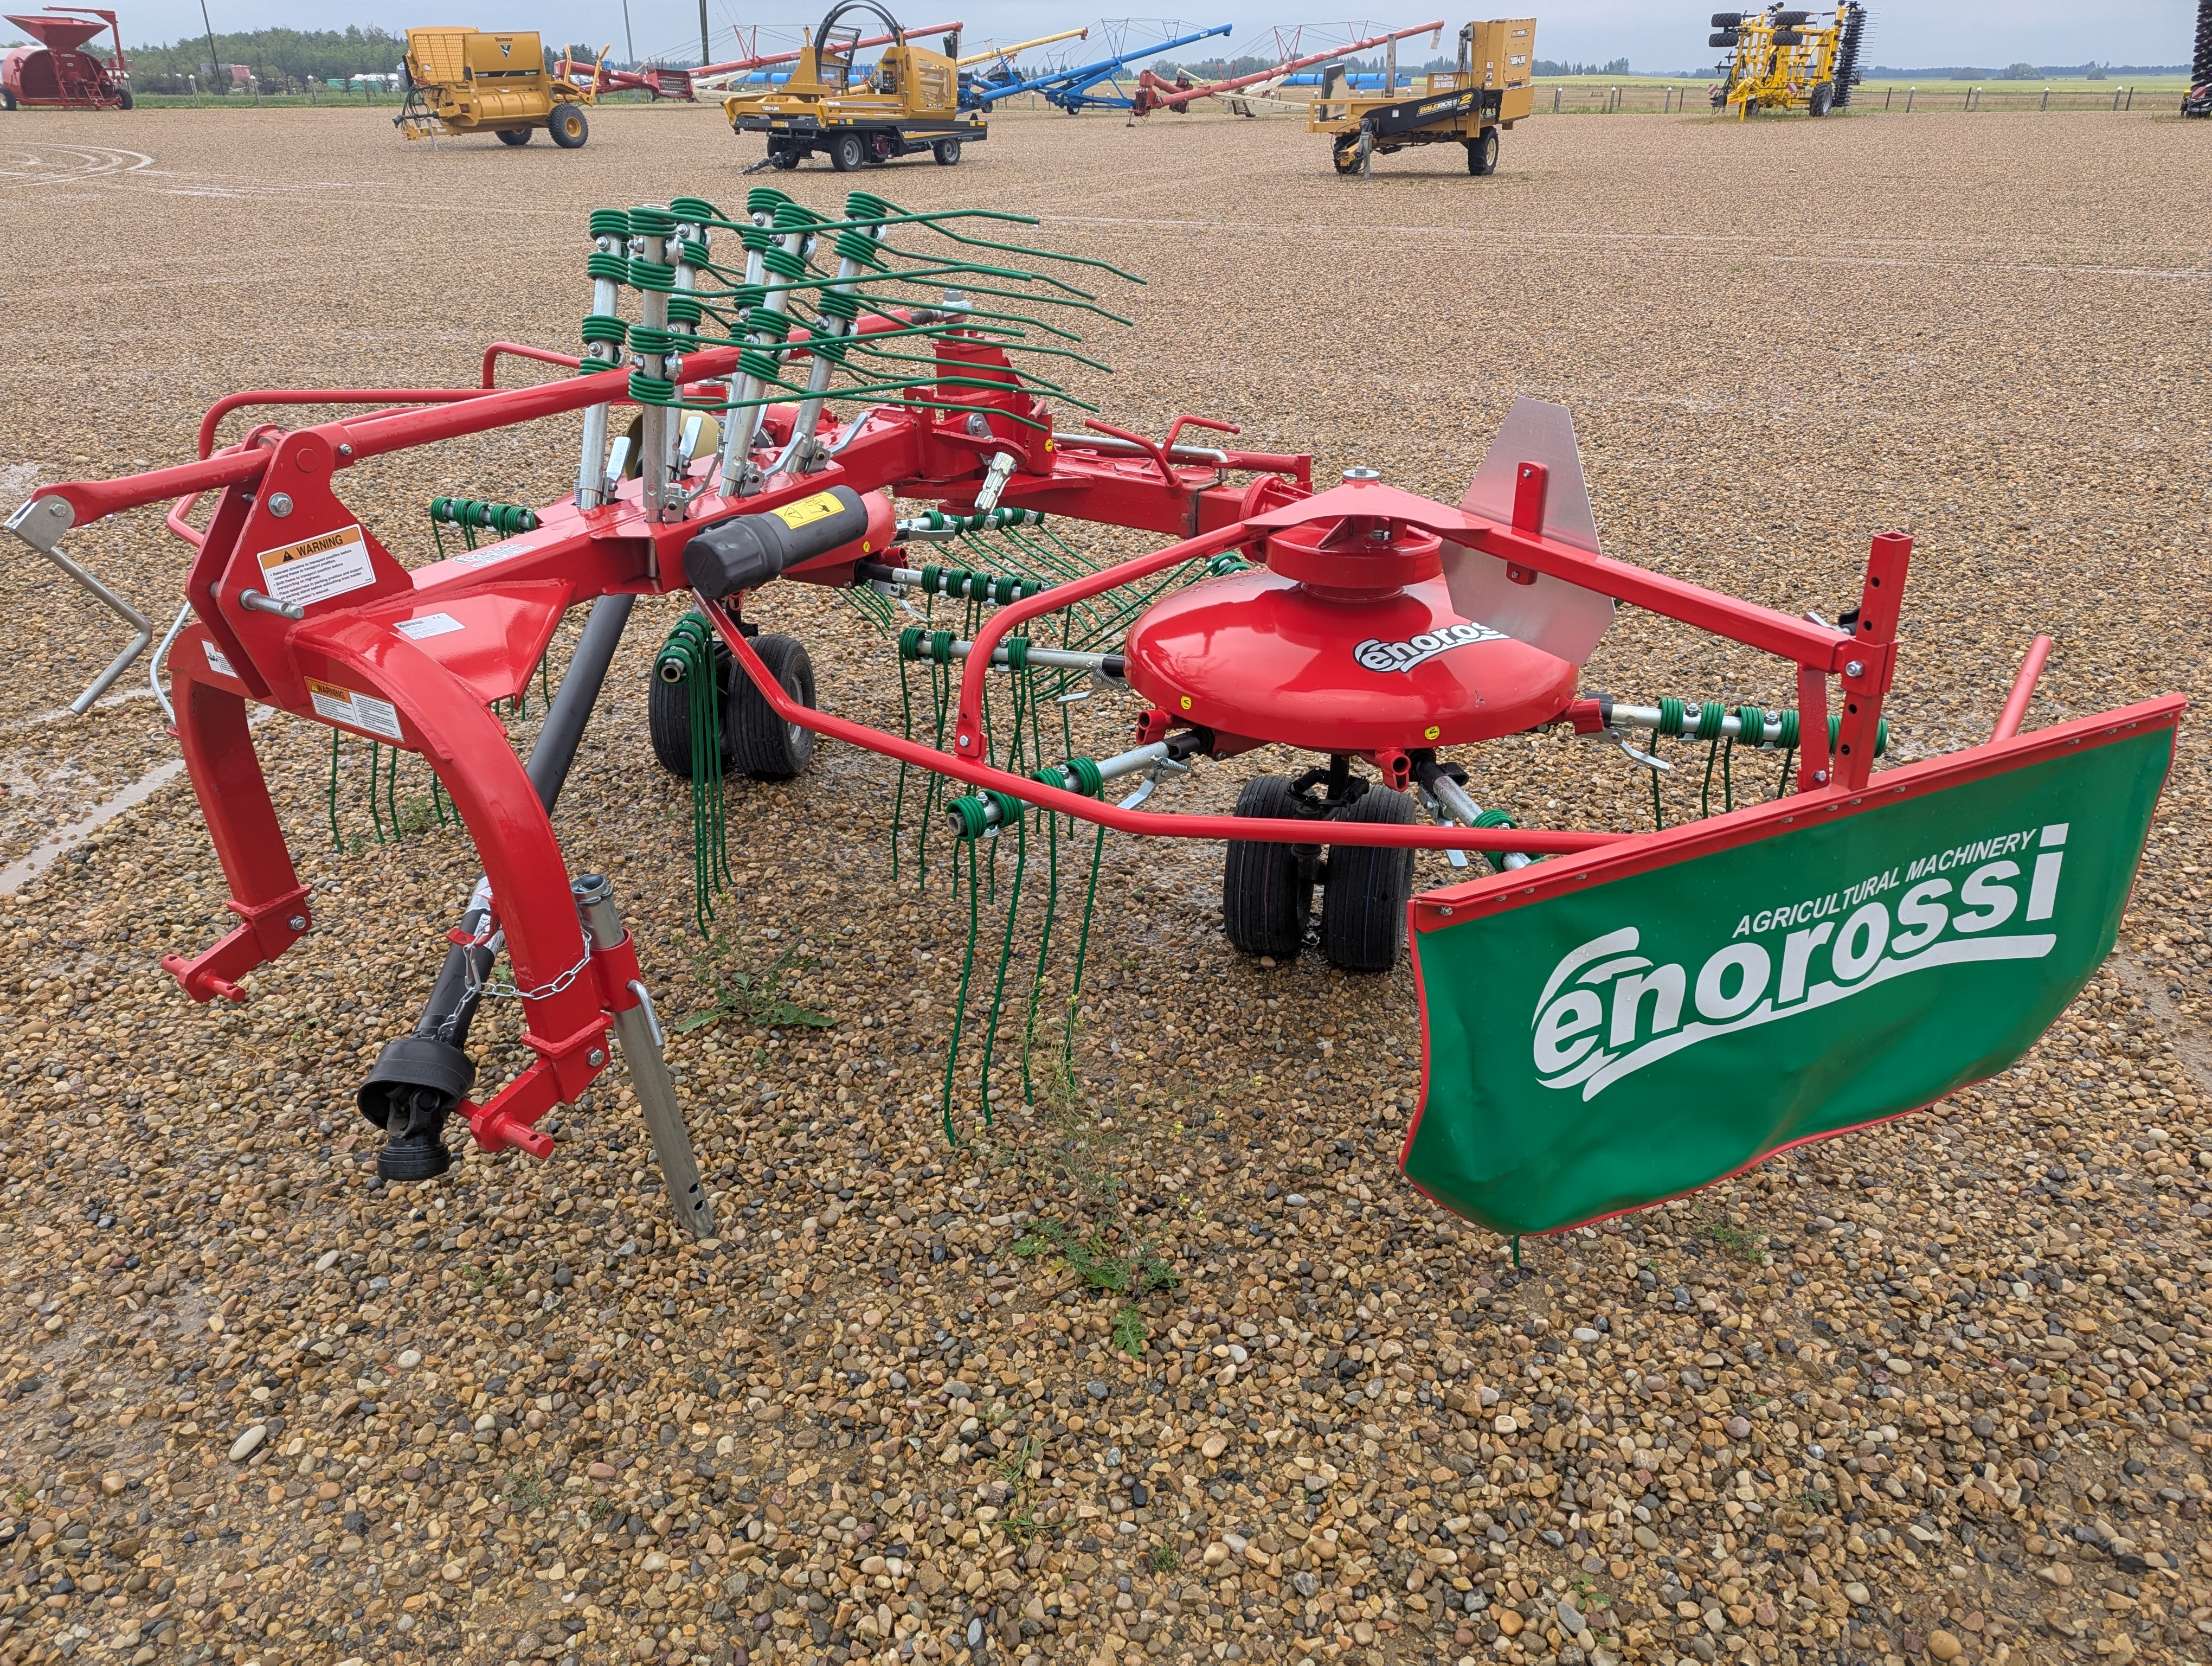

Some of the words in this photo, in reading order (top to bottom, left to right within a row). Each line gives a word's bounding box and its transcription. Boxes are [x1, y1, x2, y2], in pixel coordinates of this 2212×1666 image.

[296, 535, 343, 556] WARNING
[317, 684, 345, 700] WARNING
[1732, 867, 1900, 939] AGRICULTURAL
[1905, 829, 2037, 882] MACHINERY
[1532, 823, 2069, 1101] enorossi
